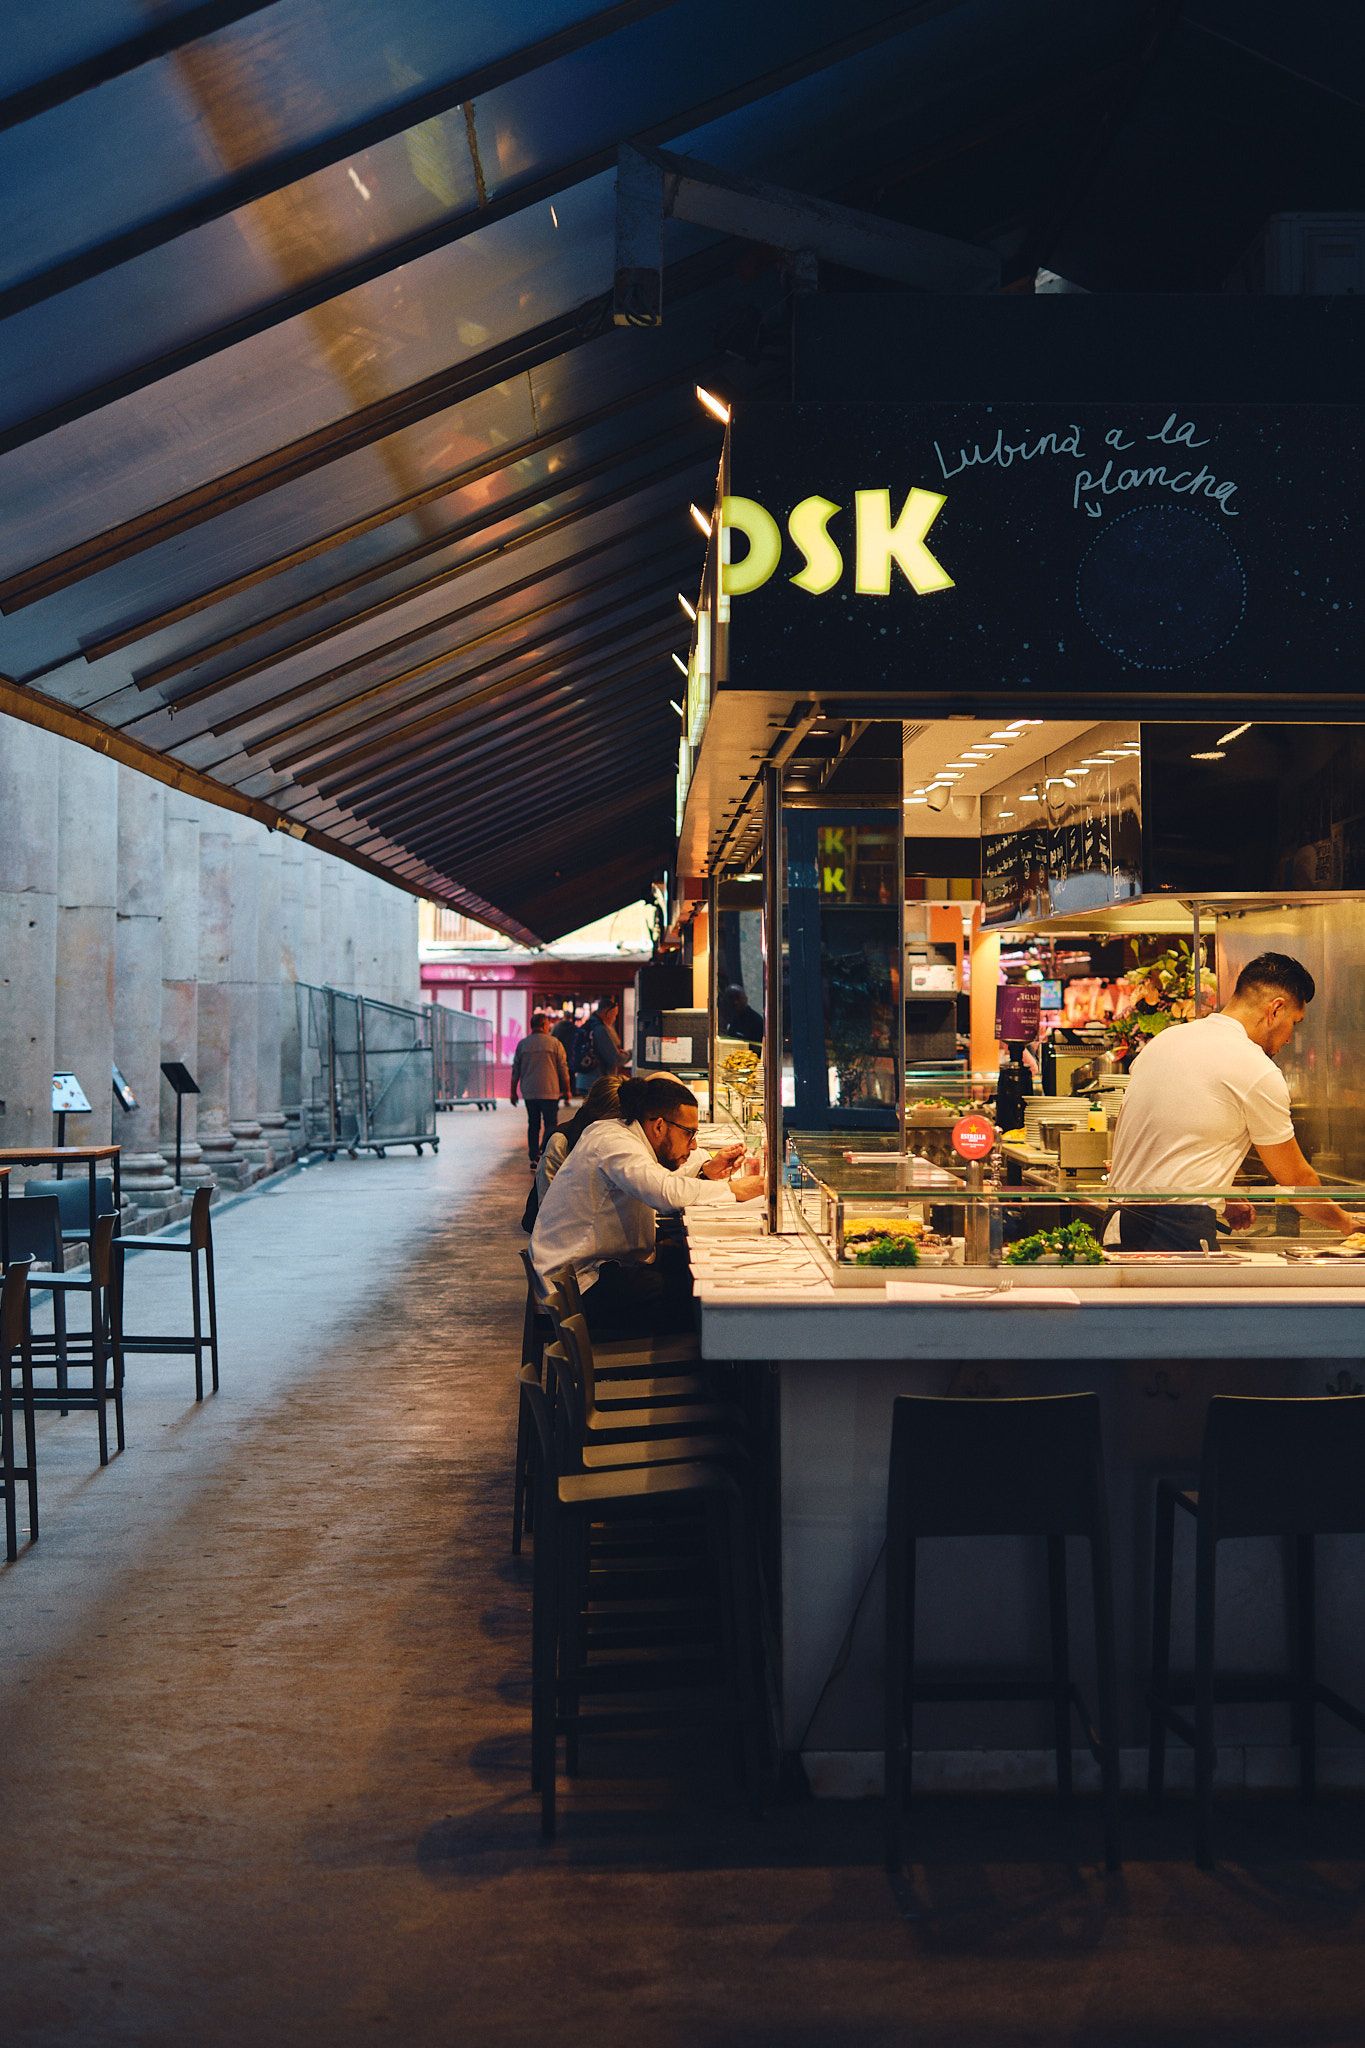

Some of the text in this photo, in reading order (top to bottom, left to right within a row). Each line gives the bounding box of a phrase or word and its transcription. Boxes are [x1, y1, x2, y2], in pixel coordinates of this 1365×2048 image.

[934, 412, 1211, 479] Lubina a la
[1073, 459, 1240, 516] plancha
